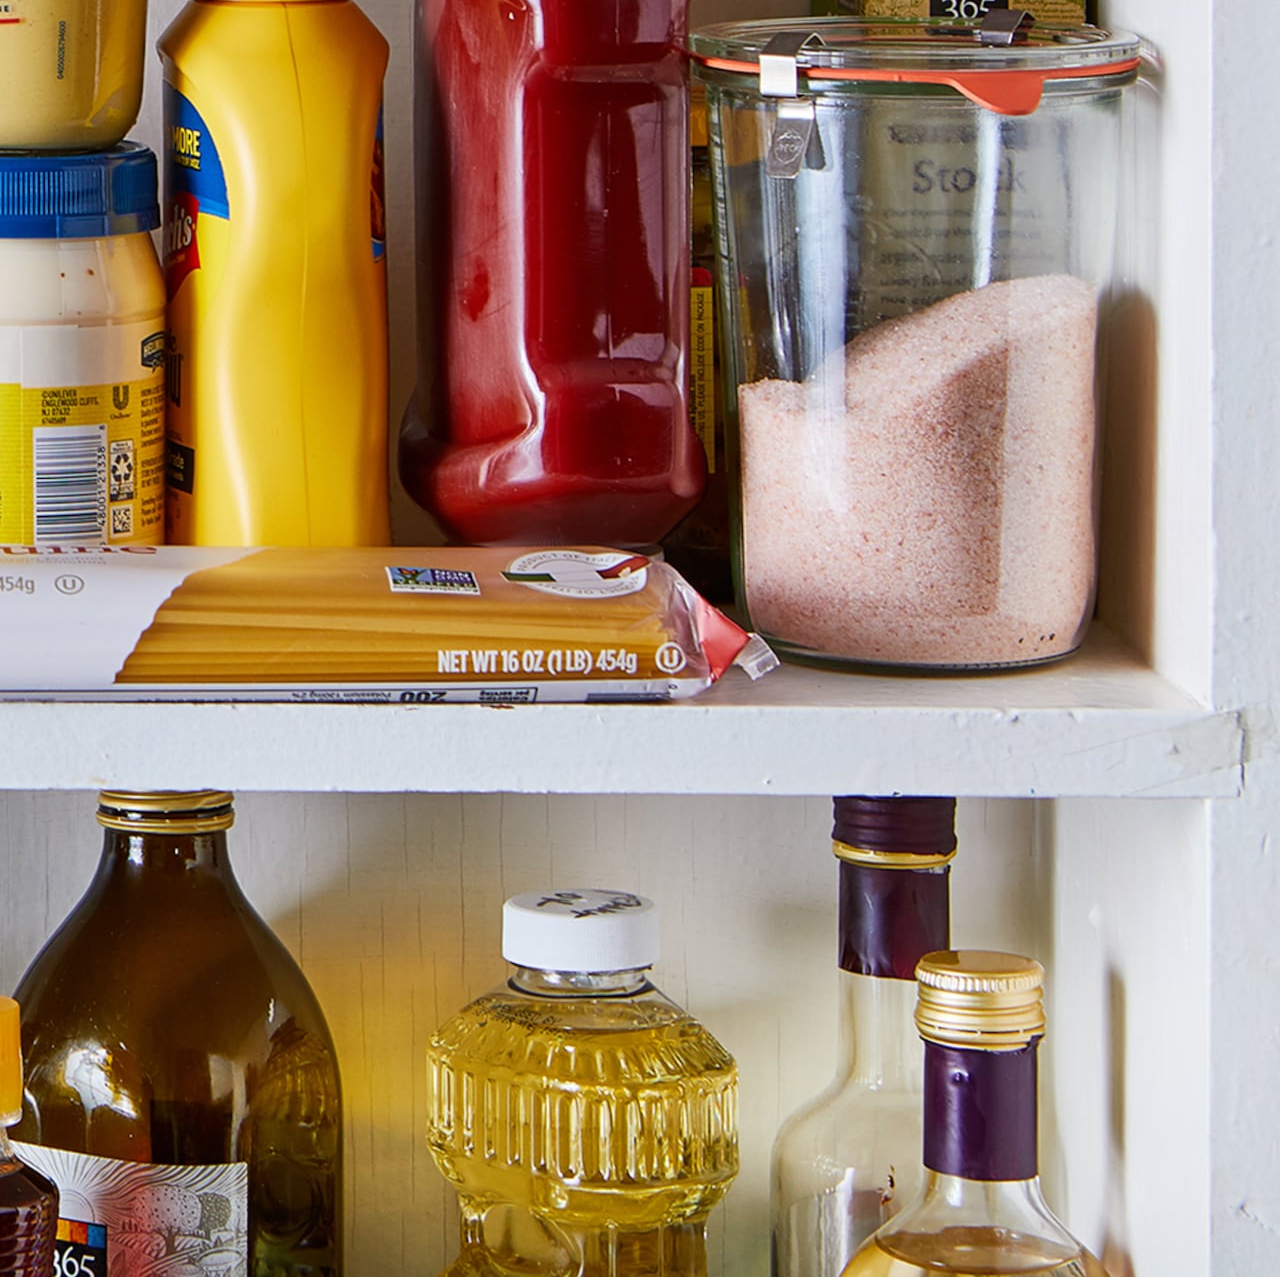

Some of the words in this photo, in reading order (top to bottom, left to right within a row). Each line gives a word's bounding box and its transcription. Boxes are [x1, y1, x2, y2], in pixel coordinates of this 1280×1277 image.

[41, 398, 78, 408] ENGLEWOOD
[96, 445, 107, 483] 21338
[437, 650, 469, 673] NET
[471, 650, 499, 673] WT
[501, 650, 519, 673] 16
[522, 650, 545, 673] OZ
[547, 650, 562, 675] (1
[565, 650, 593, 675] LB)
[595, 649, 638, 674] 454g
